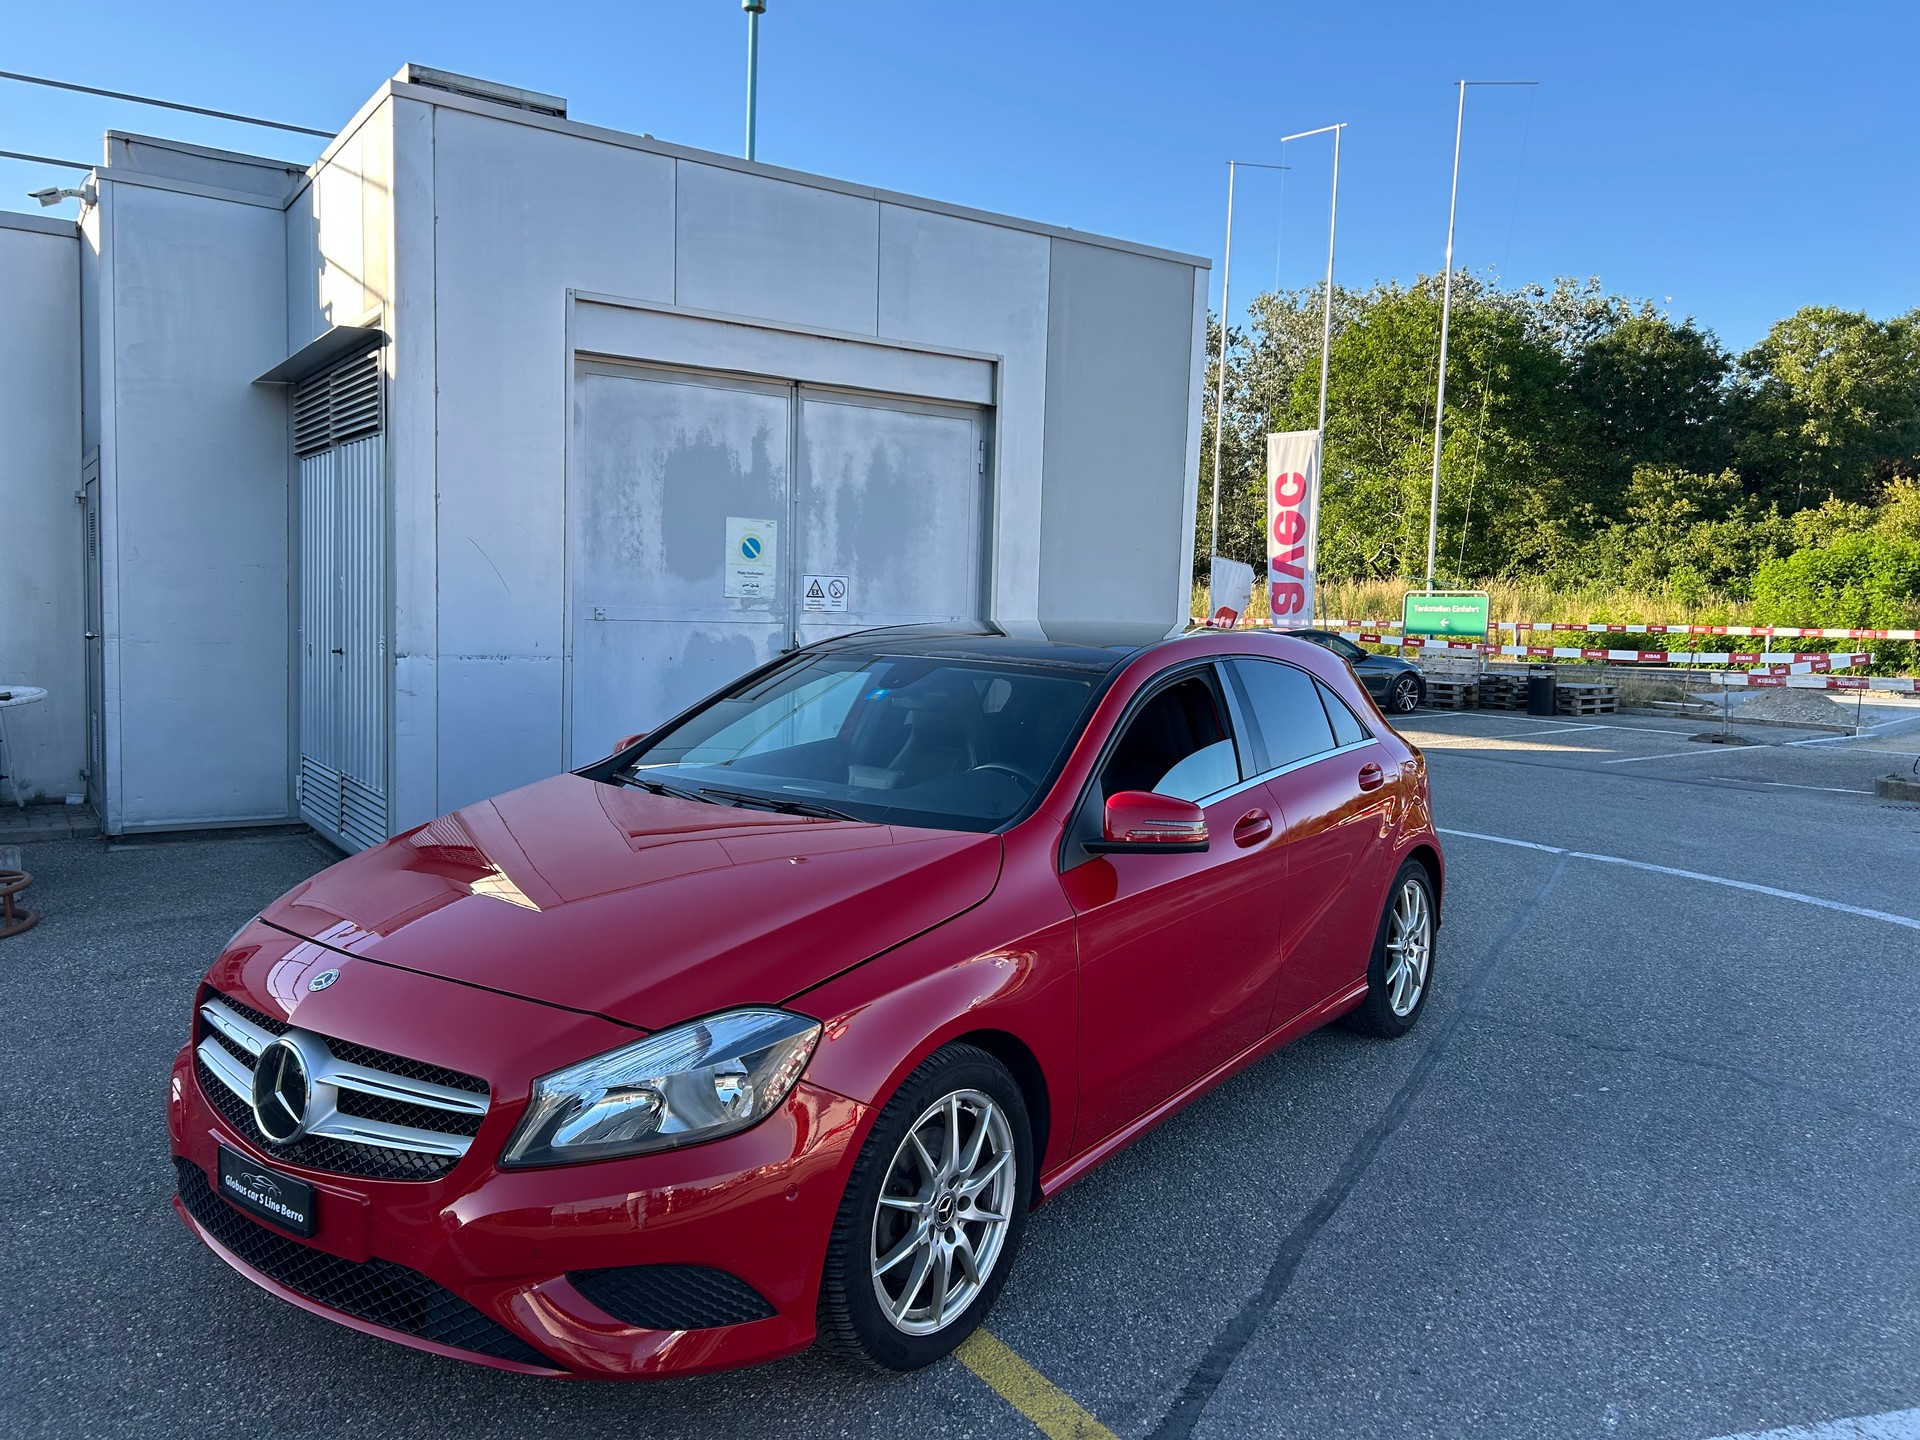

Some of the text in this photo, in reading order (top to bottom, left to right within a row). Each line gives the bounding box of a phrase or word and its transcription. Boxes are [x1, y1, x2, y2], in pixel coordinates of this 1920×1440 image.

[1413, 604, 1480, 613] Tankstellen Einfahrt
[225, 1174, 304, 1223] Globus car S Line Berro
